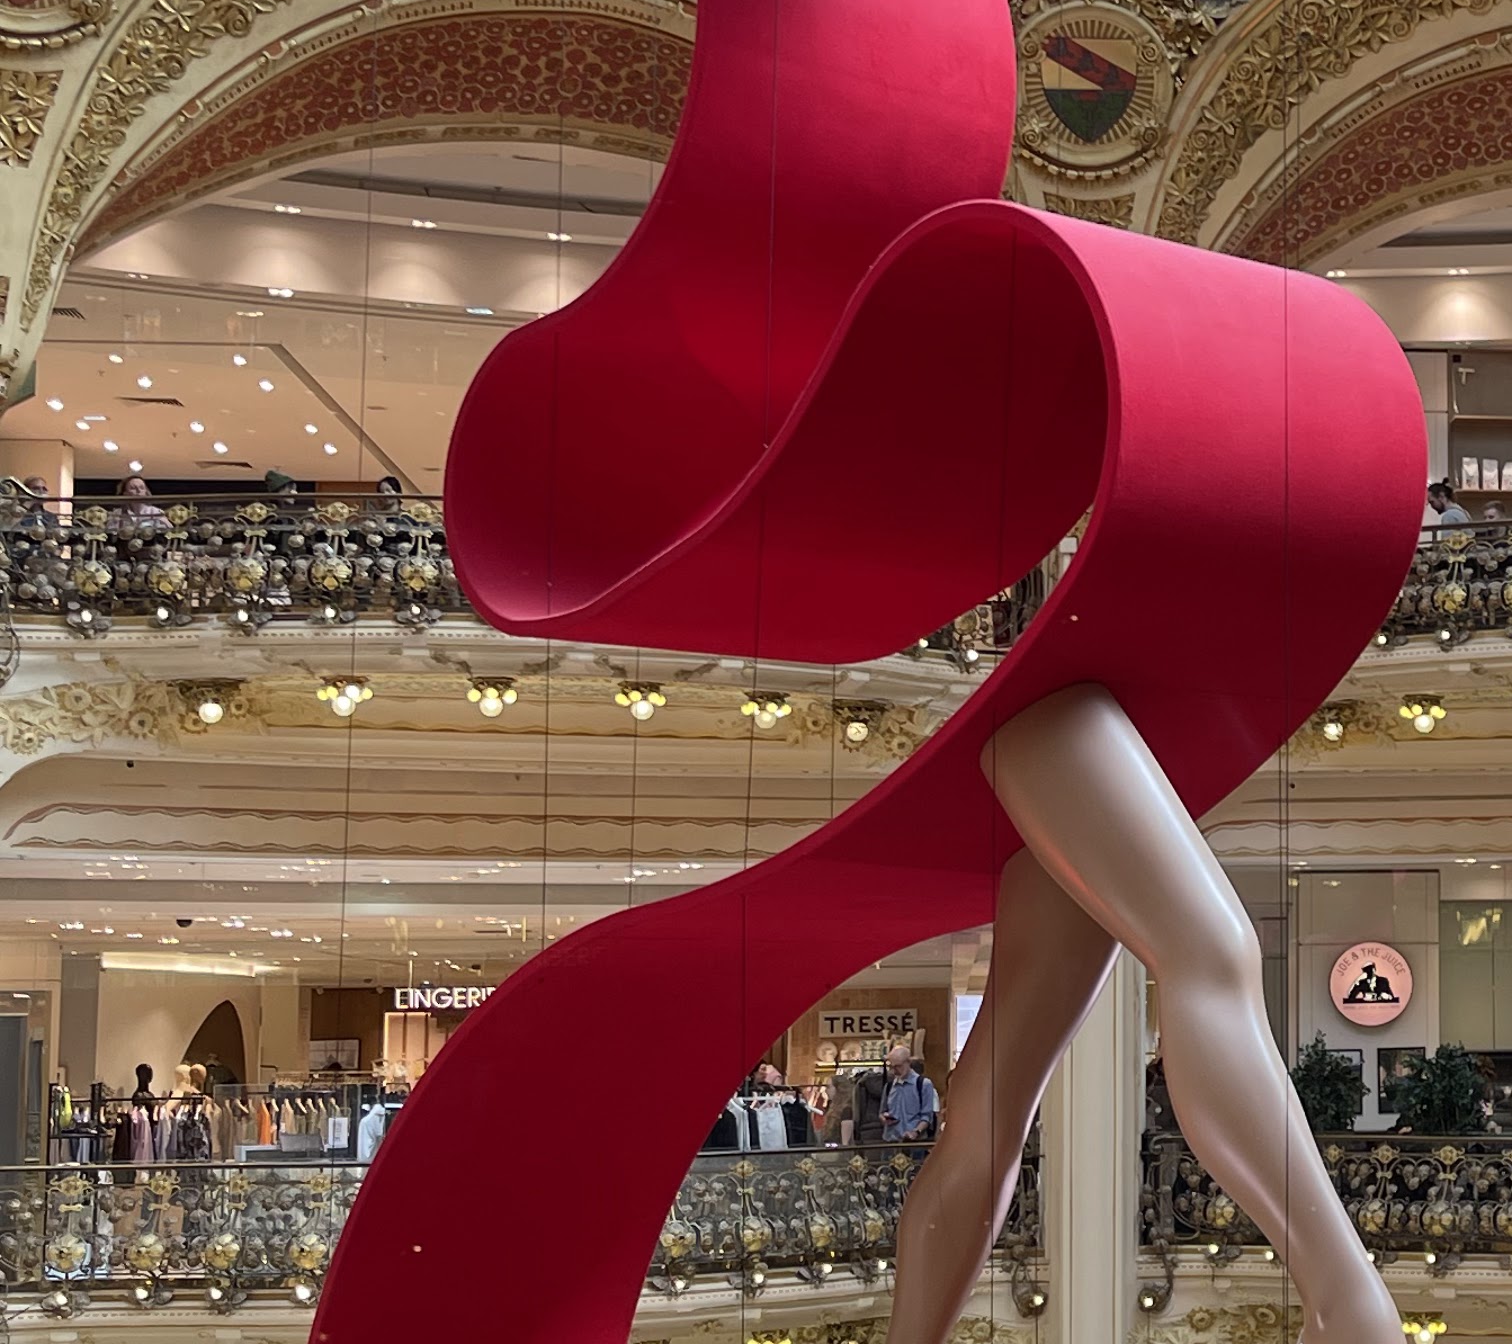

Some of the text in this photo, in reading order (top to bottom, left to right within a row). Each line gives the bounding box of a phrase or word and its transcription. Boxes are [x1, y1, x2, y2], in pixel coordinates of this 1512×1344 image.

[1336, 957, 1352, 977] JOE
[1360, 947, 1381, 958] THE
[1380, 952, 1406, 976] JUICE
[823, 1011, 915, 1034] TRESSÉ
